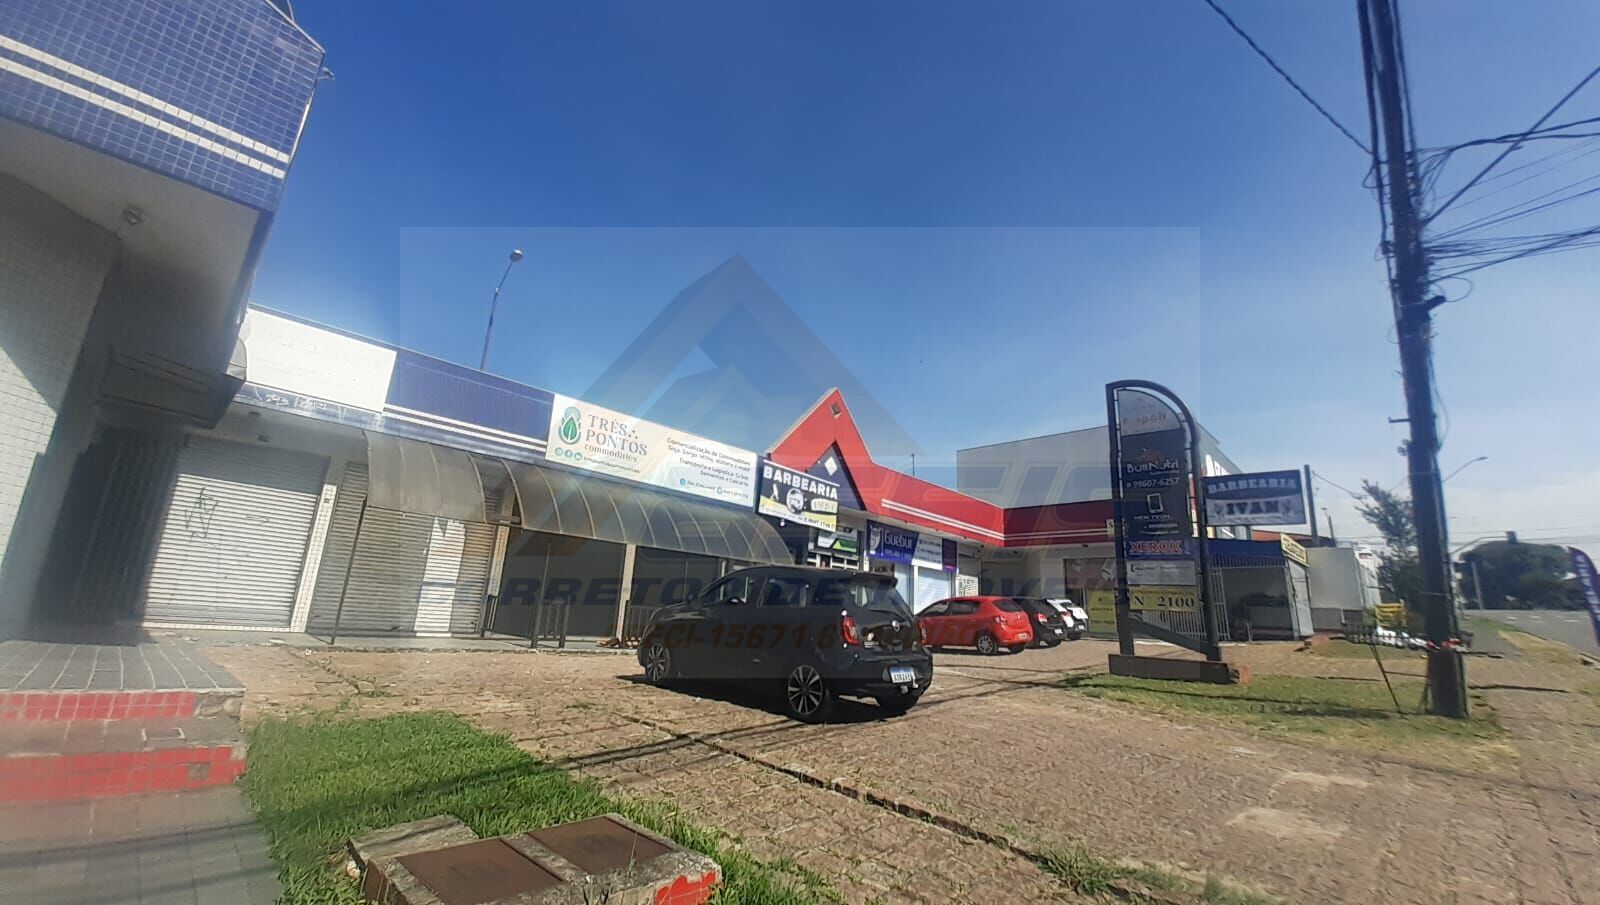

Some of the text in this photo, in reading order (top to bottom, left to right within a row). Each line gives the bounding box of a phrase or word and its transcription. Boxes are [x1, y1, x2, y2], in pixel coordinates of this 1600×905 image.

[586, 430, 648, 456] PONTOS
[763, 466, 838, 500] BARBEARIA
[1207, 478, 1297, 494] BARBEARIA
[1225, 500, 1280, 515] IVAN
[1128, 539, 1184, 554] XEROX
[1156, 595, 1196, 609] 2100
